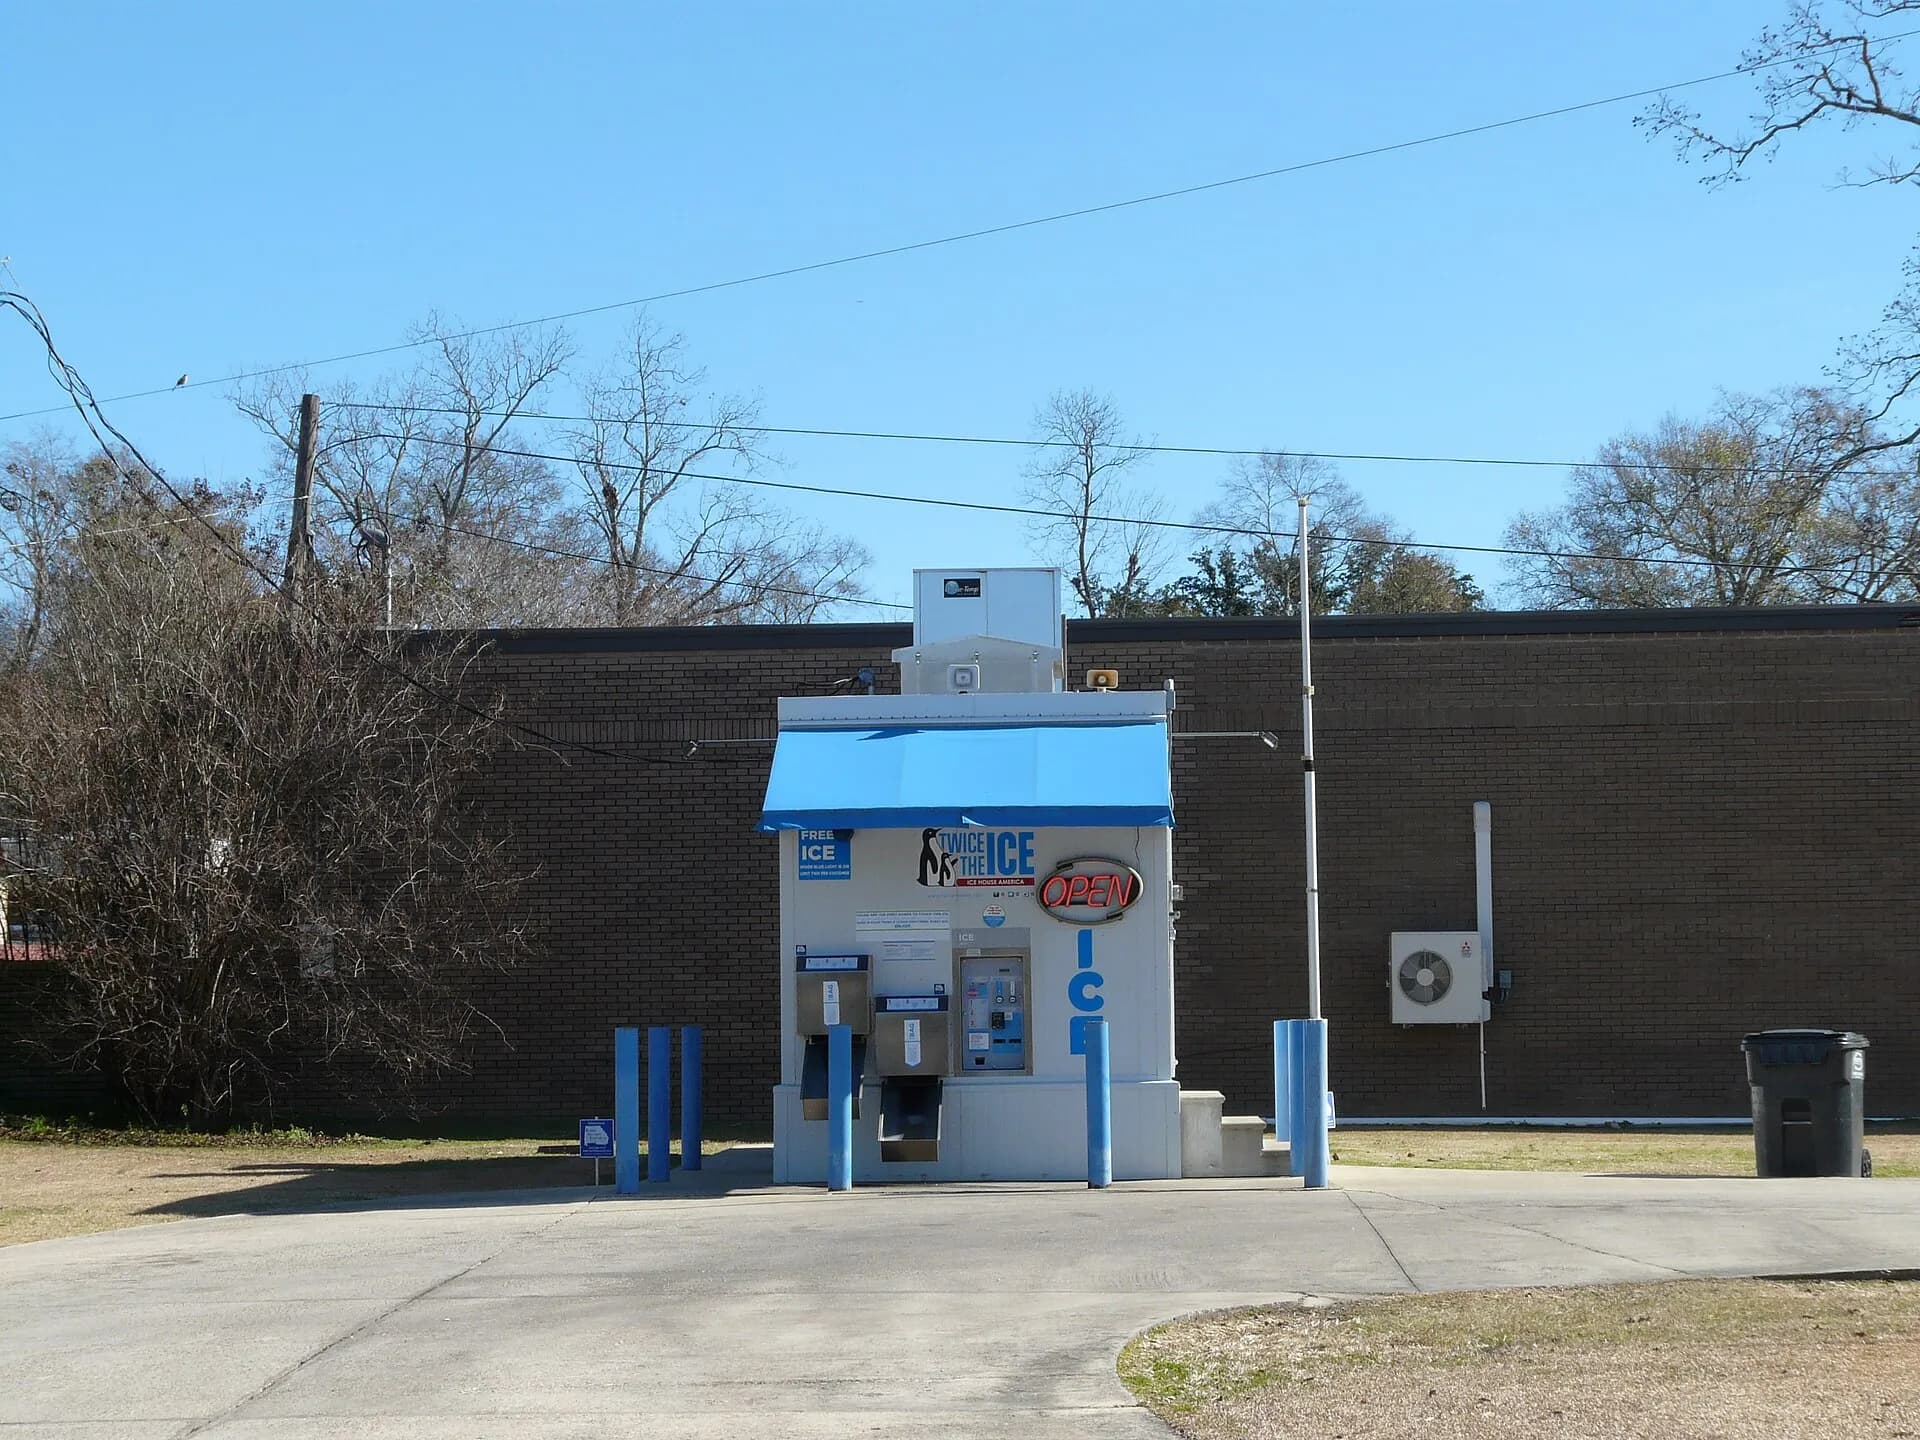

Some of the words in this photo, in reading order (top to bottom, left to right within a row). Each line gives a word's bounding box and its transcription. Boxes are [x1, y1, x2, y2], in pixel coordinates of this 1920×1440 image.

[801, 830, 835, 840] FREE
[939, 832, 985, 853] TWICE
[802, 845, 835, 861] ICE
[986, 831, 1035, 876] ICE
[960, 856, 985, 876] THE
[1043, 875, 1134, 907] OPEN
[959, 934, 975, 942] ICE
